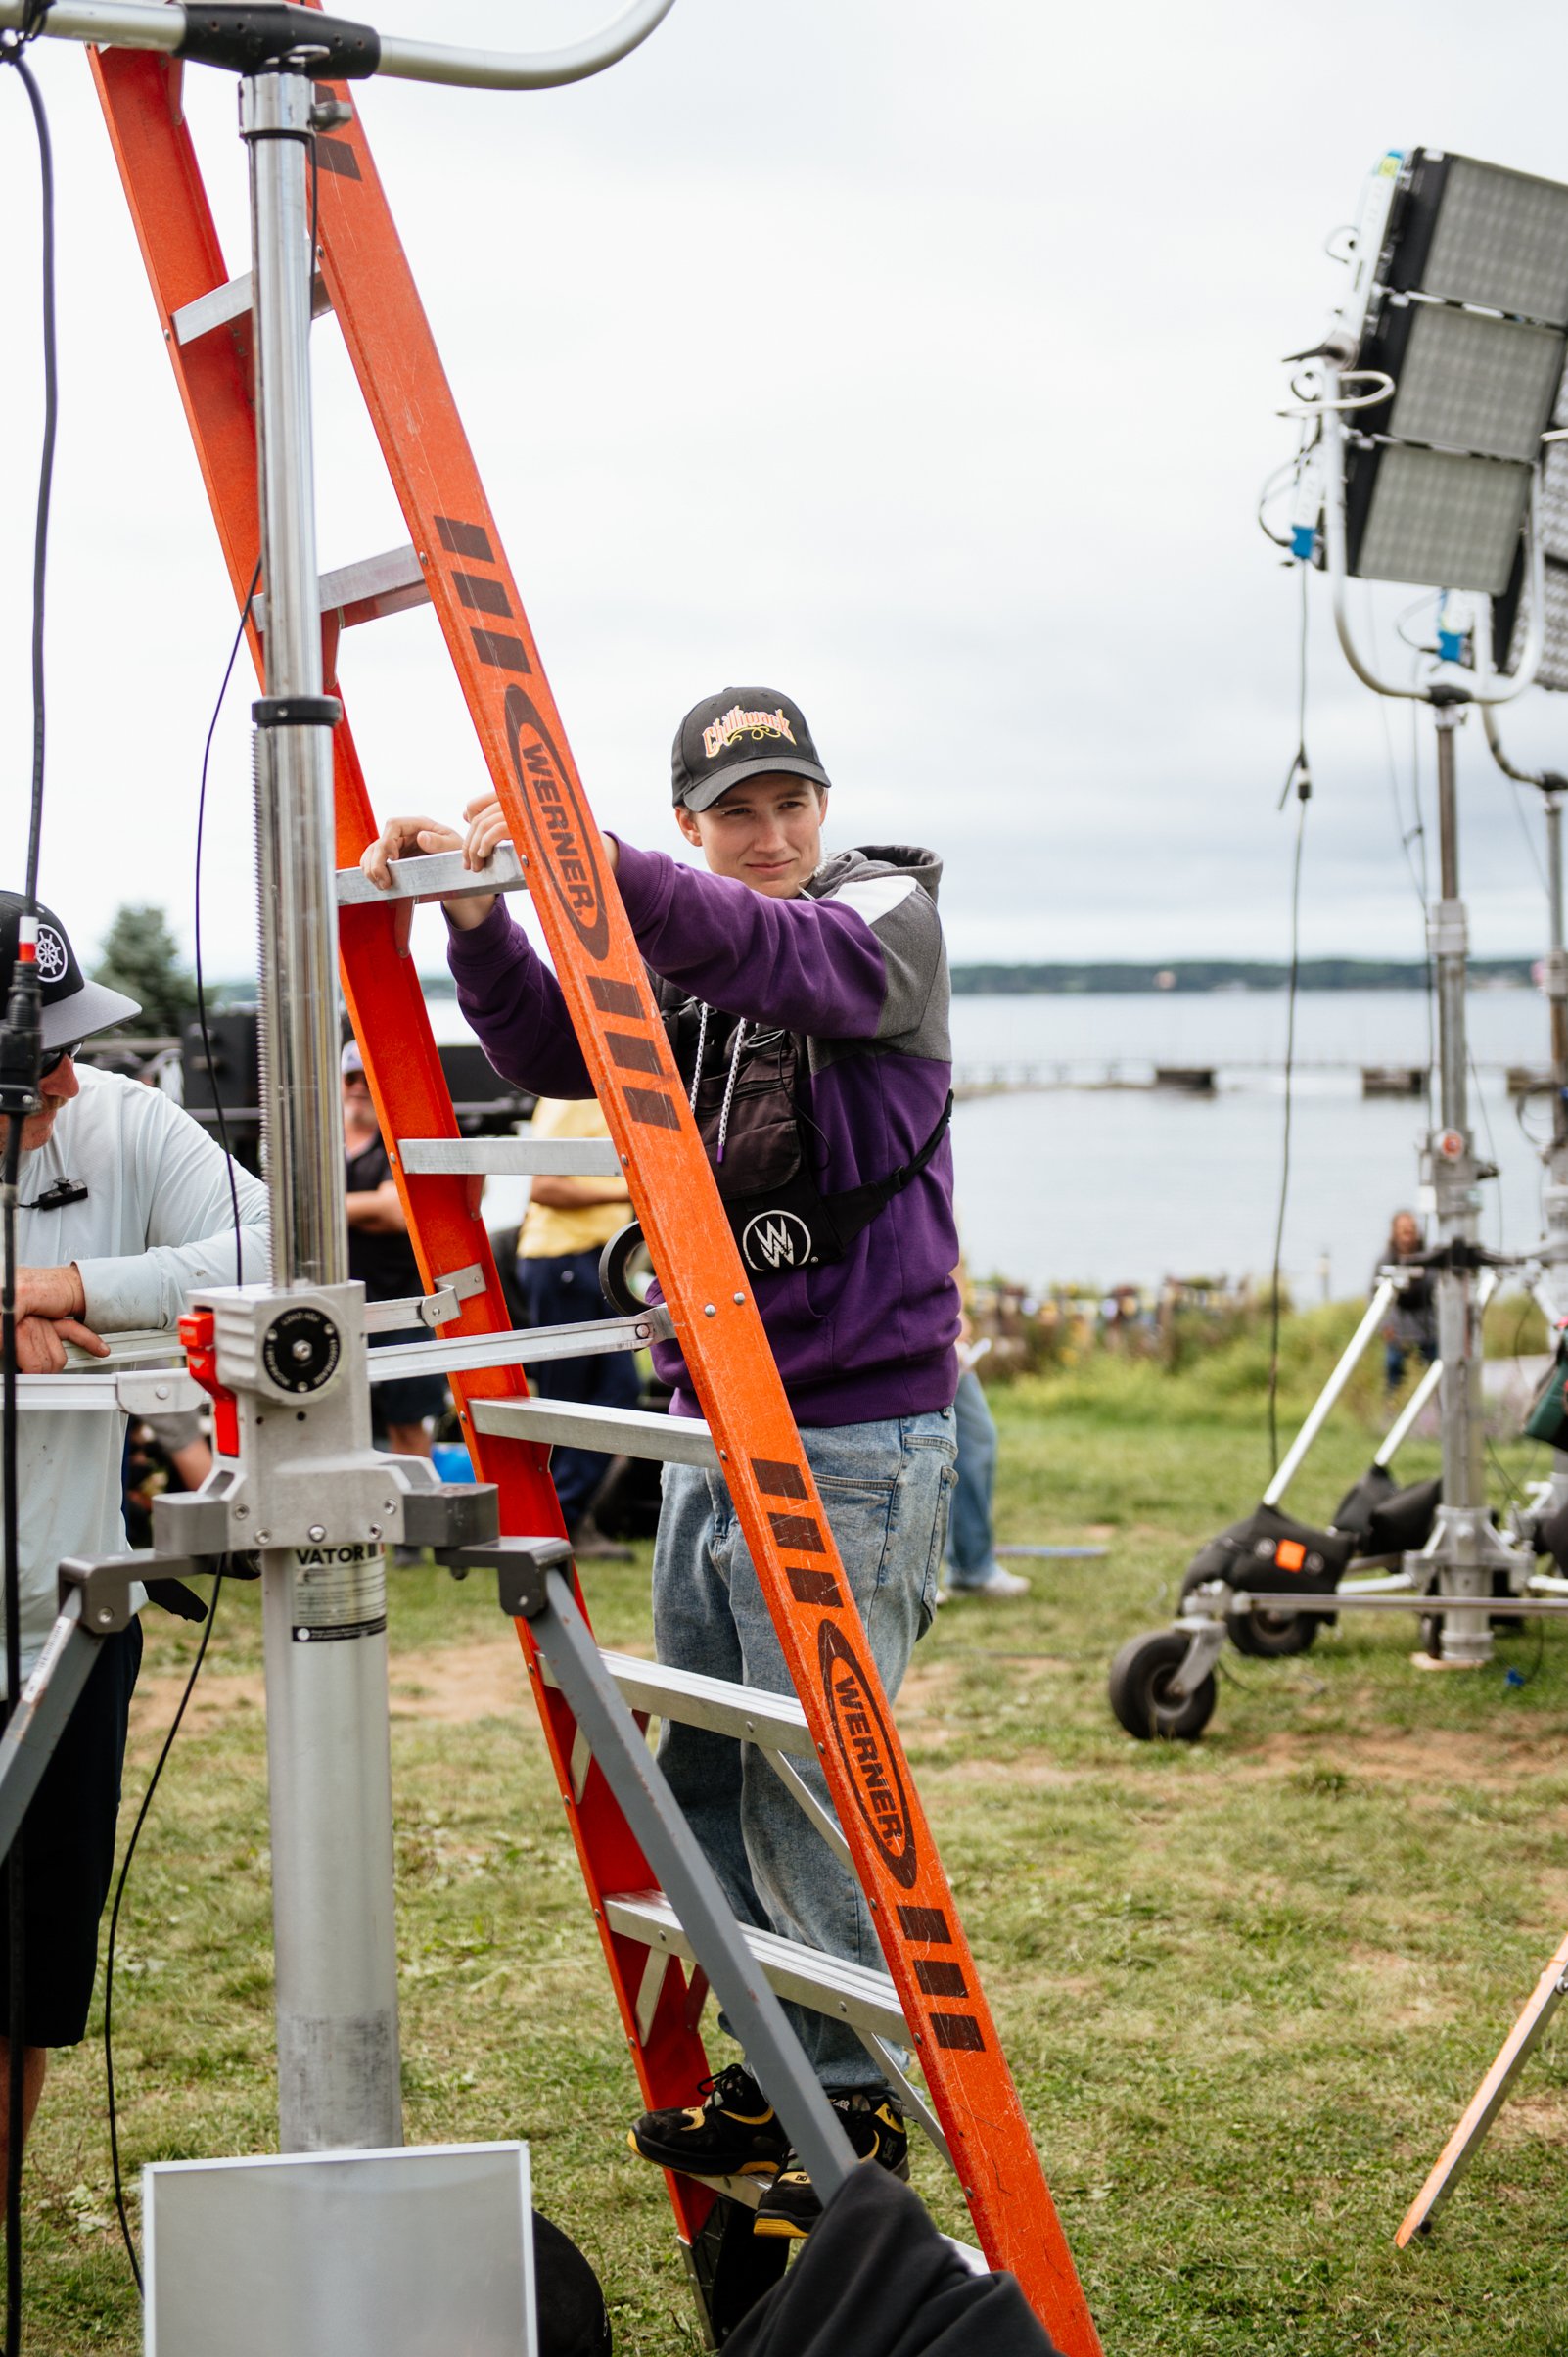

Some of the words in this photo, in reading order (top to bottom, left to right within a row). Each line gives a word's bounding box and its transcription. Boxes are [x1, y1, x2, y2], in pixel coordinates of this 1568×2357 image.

[702, 705, 797, 759] Chilliwack
[522, 742, 596, 912] WERNER
[296, 1545, 365, 1565] VATOR
[834, 1676, 904, 1841] WERNER
